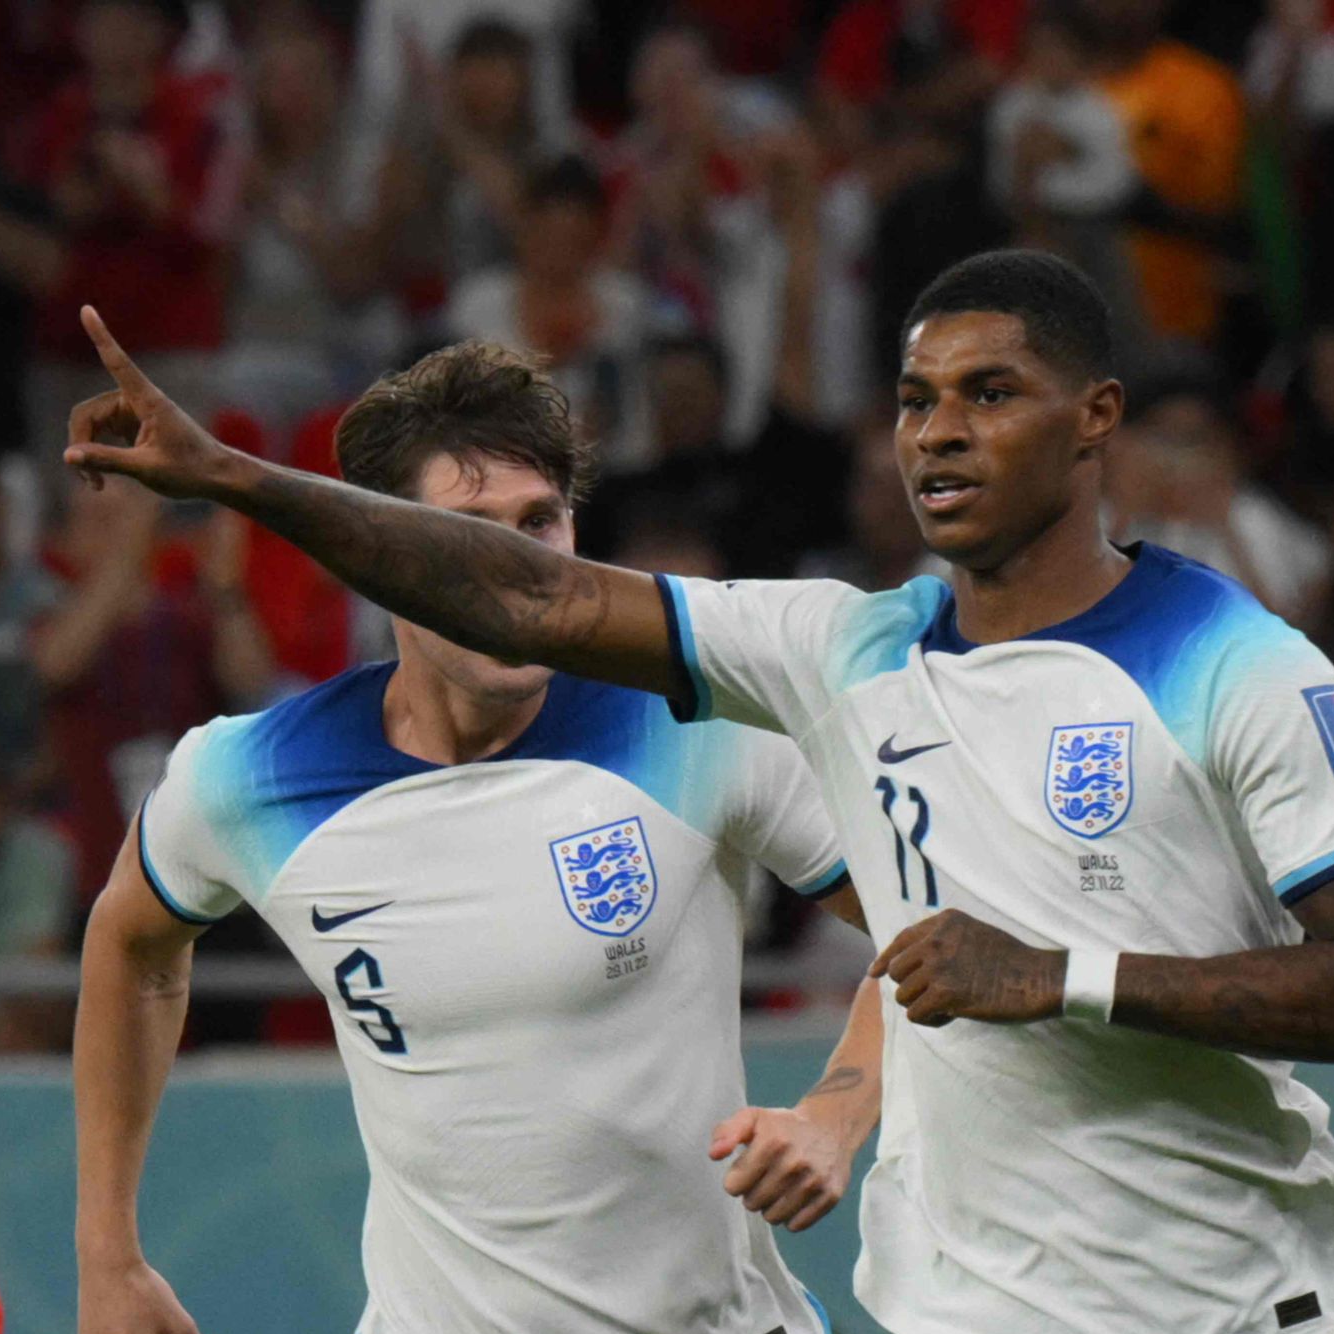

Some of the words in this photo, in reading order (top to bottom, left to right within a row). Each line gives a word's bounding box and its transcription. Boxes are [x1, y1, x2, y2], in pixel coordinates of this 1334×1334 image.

[874, 774, 939, 907] 11
[1078, 854, 1119, 870] WALES
[604, 937, 645, 960] WALES
[334, 946, 408, 1054] 5
